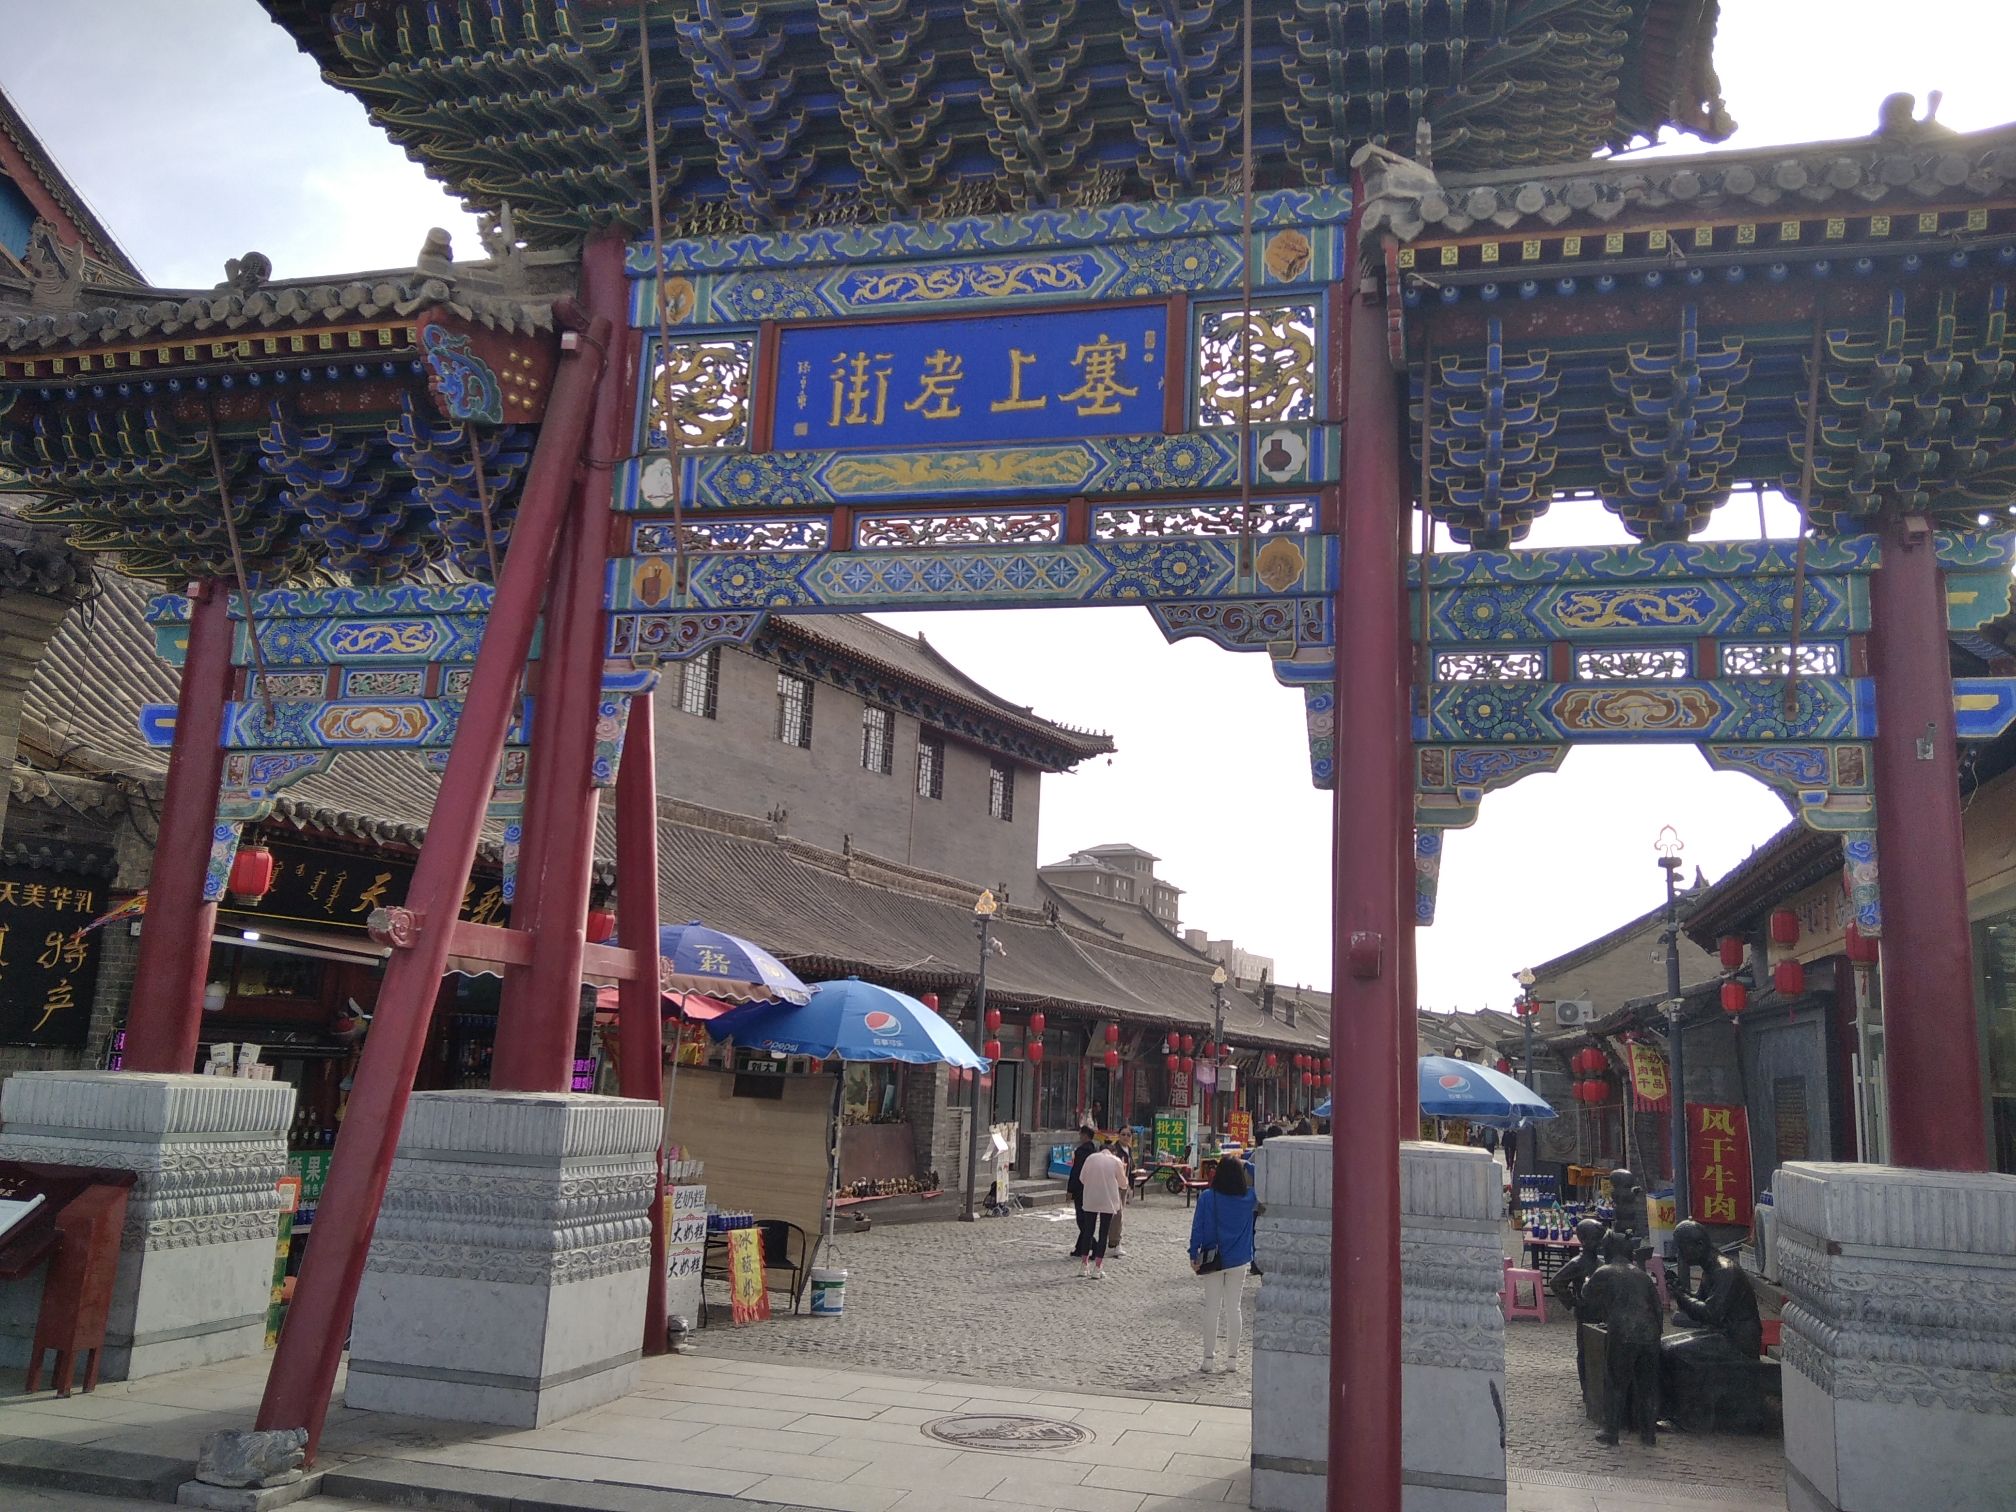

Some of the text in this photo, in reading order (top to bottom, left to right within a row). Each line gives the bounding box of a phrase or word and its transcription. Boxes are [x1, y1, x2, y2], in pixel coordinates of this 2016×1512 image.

[32, 926, 89, 1032] 特产
[770, 1041, 799, 1053] pepsi
[1156, 1120, 1185, 1135] 批发
[1157, 1137, 1185, 1152] 风干
[1699, 1107, 1737, 1221] 风干牛肉
[672, 1221, 705, 1243] 大奶糕
[668, 1255, 701, 1279] 大奶糕
